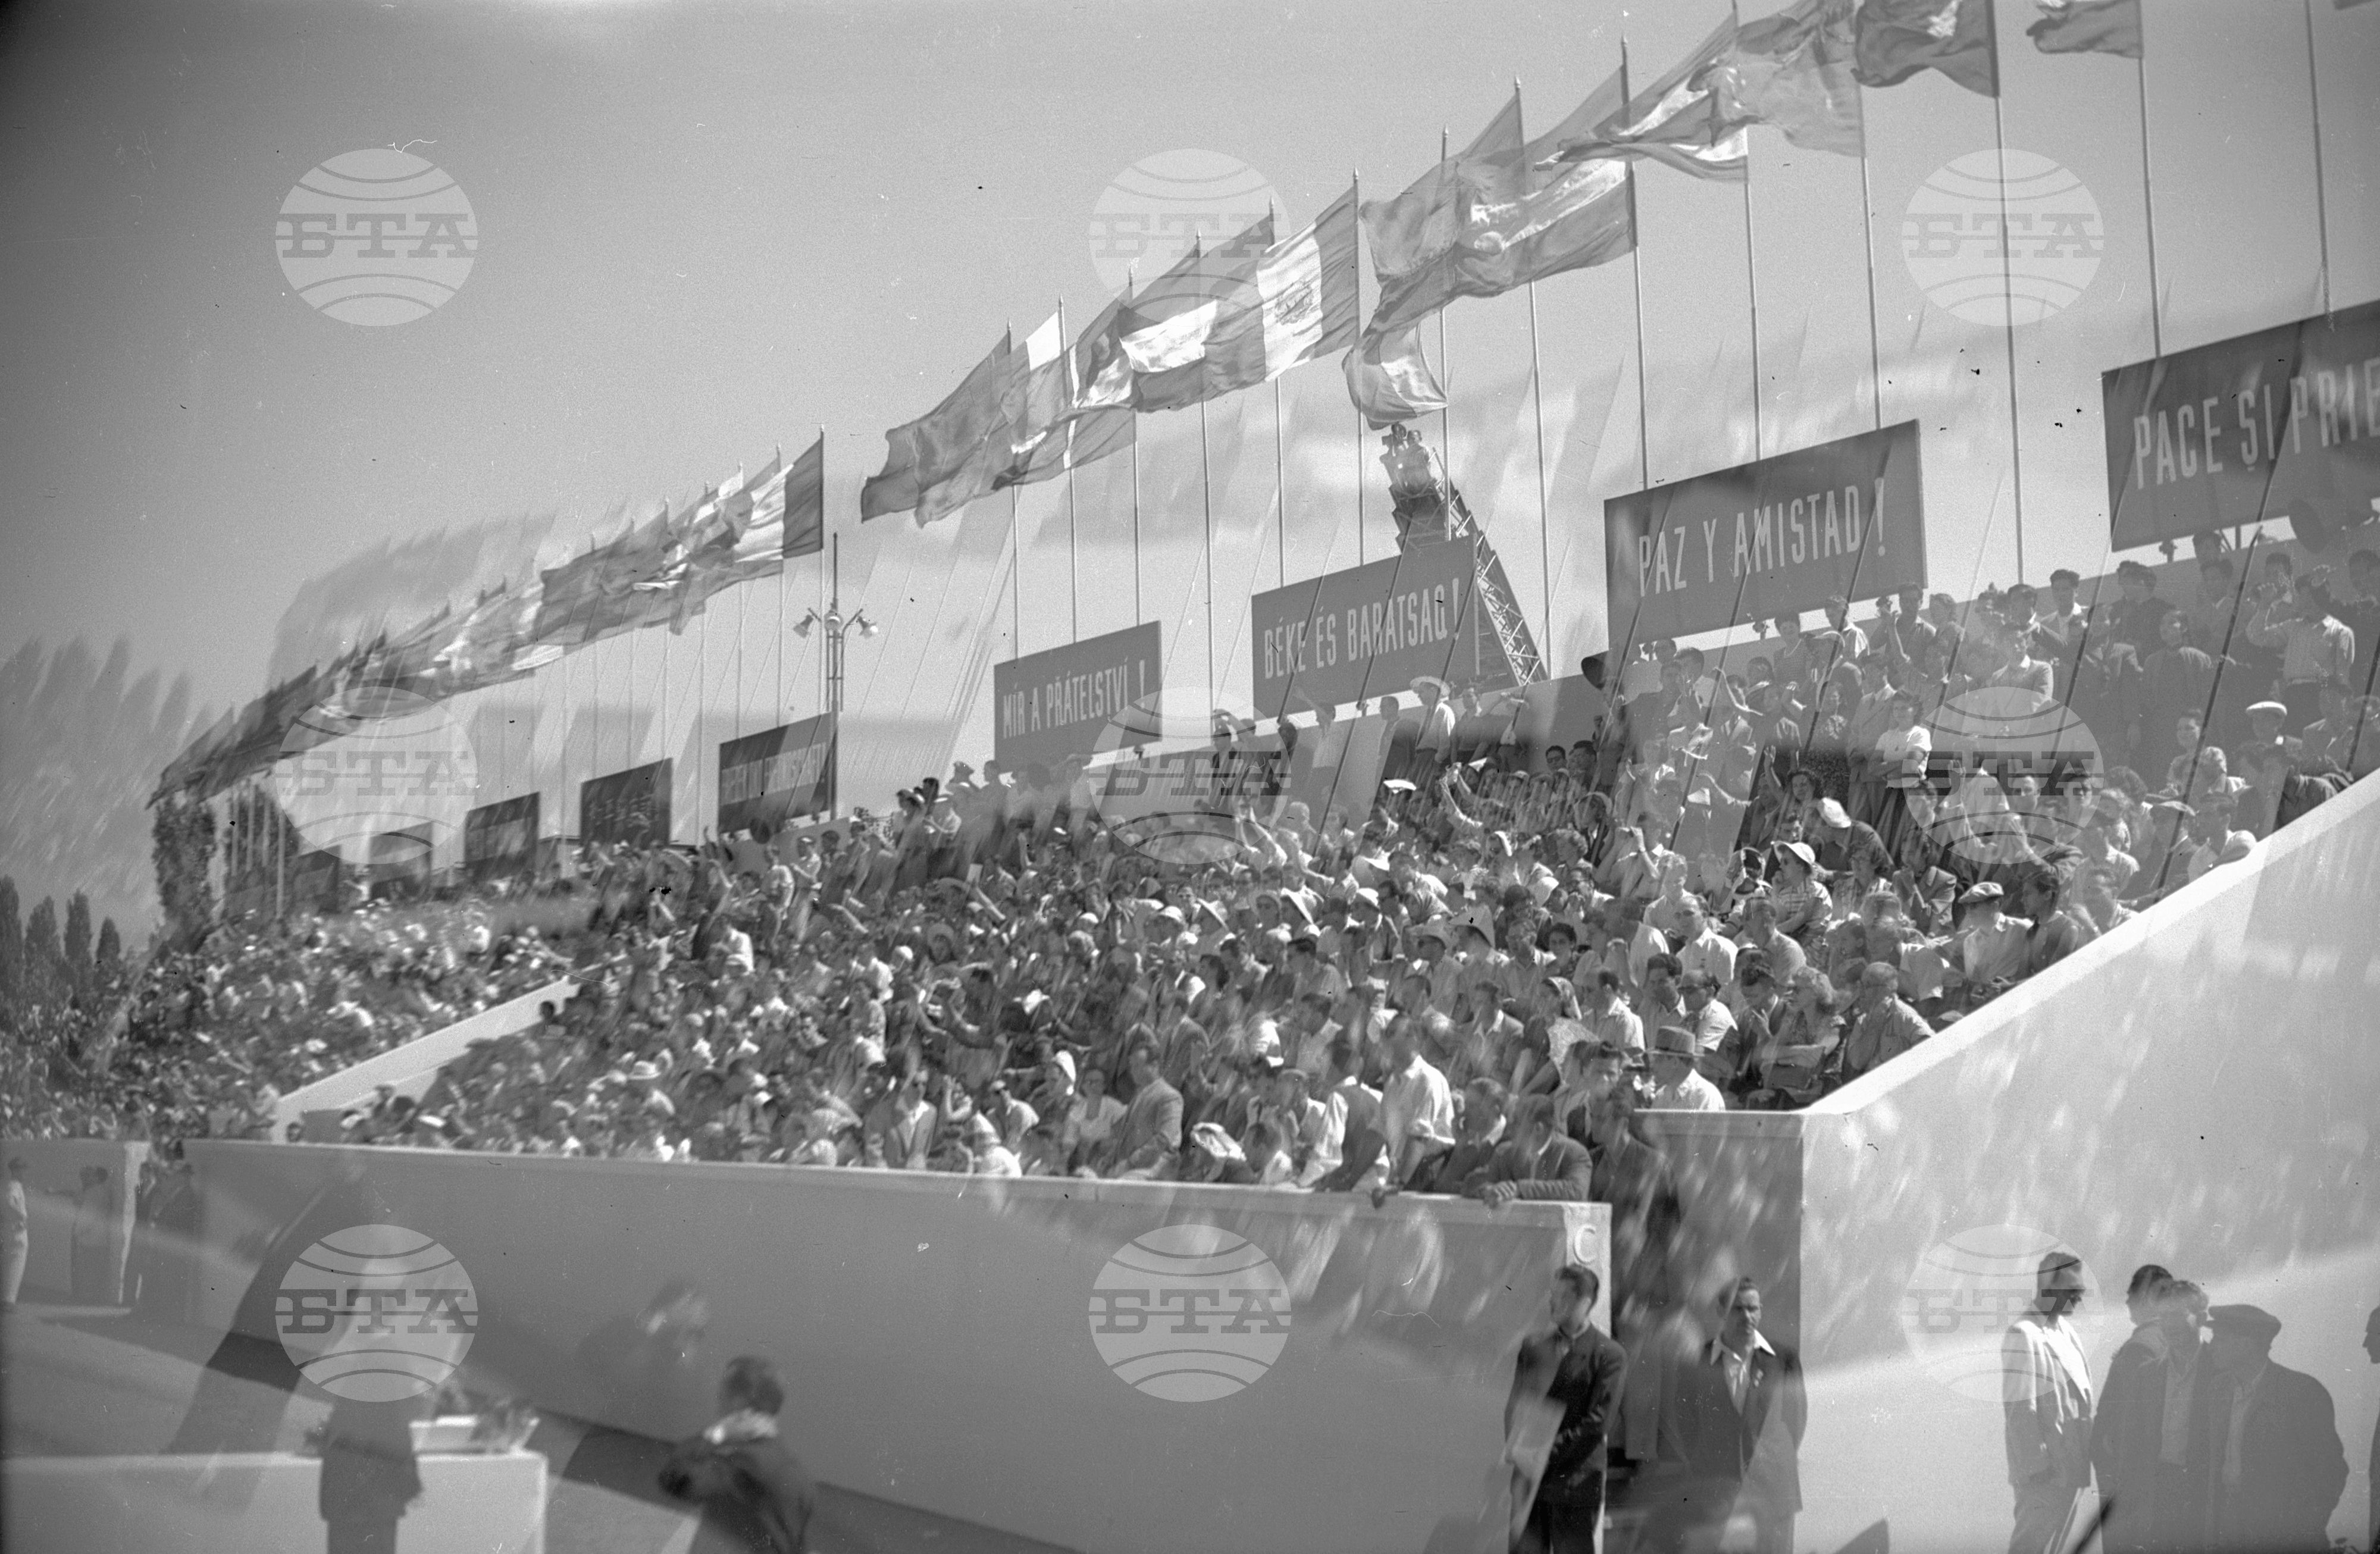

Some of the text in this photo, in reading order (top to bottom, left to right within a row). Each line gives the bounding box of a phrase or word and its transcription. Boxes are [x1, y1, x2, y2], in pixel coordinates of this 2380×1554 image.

[2134, 396, 2223, 490] PACE
[2290, 357, 2380, 454] PRIE
[1639, 526, 1687, 597] PAZ
[1703, 518, 1718, 582] Y
[1264, 616, 1307, 679] BÉKE
[1316, 606, 1336, 669] ÉS
[1003, 682, 1026, 739] MÍR
[1031, 687, 1041, 732] A
